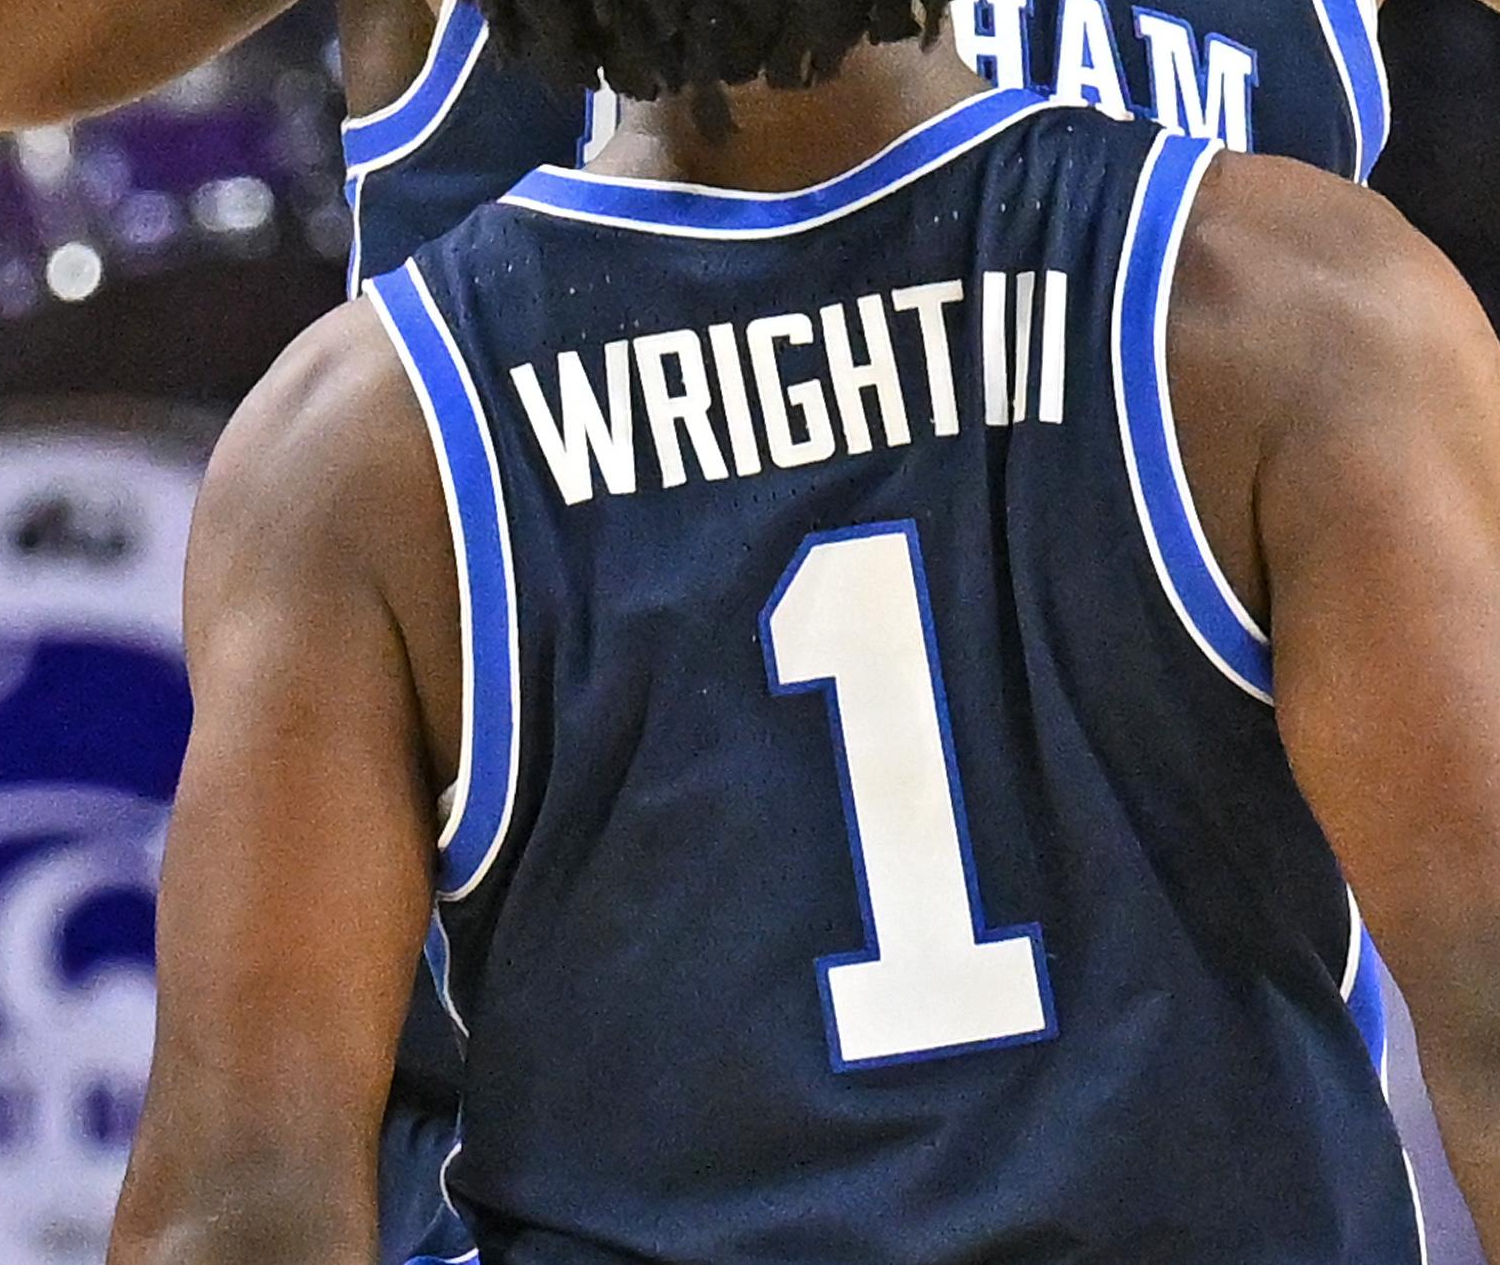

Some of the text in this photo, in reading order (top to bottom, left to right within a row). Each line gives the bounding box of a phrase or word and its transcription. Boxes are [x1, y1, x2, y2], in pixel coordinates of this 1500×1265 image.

[509, 269, 1068, 506] WRIGHT III
[758, 518, 1059, 1073] 1
